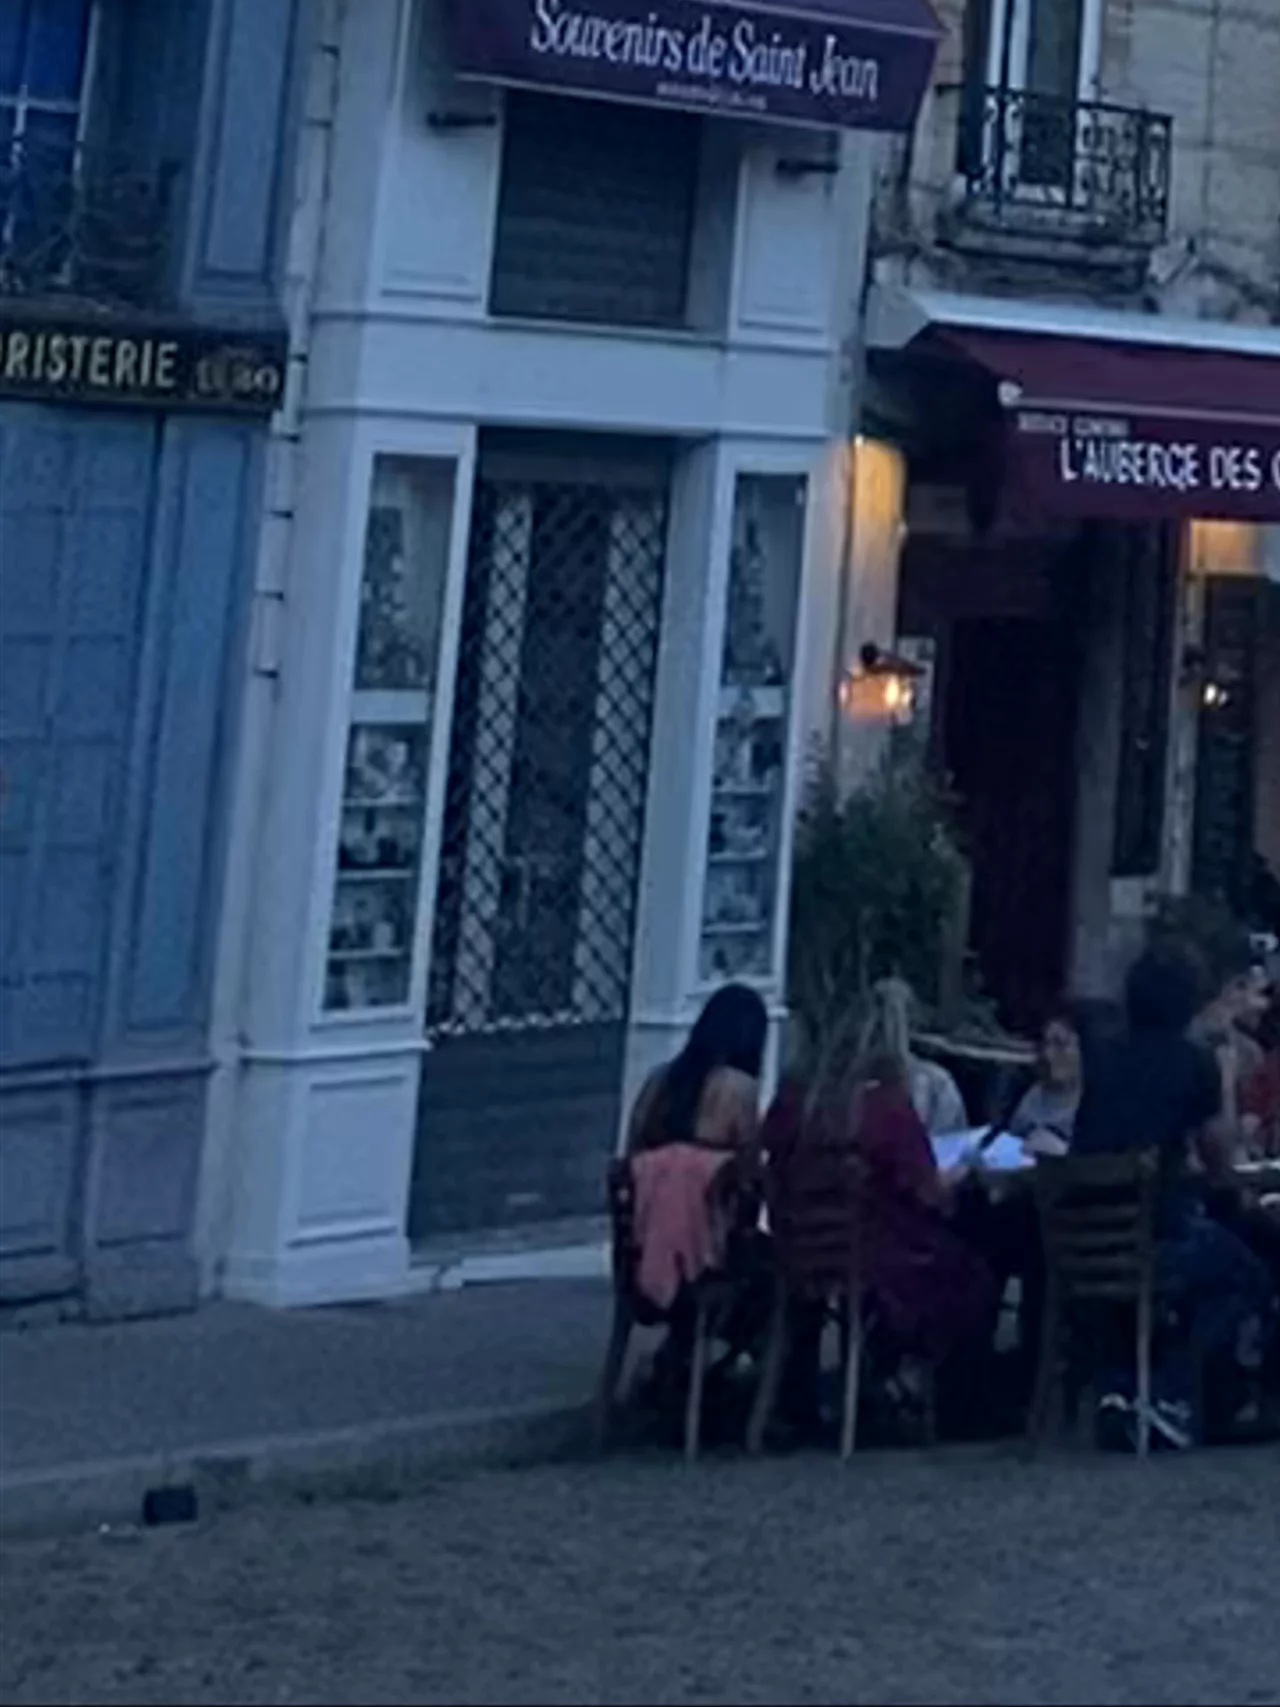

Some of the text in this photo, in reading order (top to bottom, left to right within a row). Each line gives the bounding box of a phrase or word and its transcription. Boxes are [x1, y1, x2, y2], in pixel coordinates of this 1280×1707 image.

[688, 14, 728, 78] de
[728, 20, 806, 89] Saint
[809, 34, 879, 101] Jean
[0, 331, 178, 388] RISTERIE
[1210, 445, 1262, 491] DES
